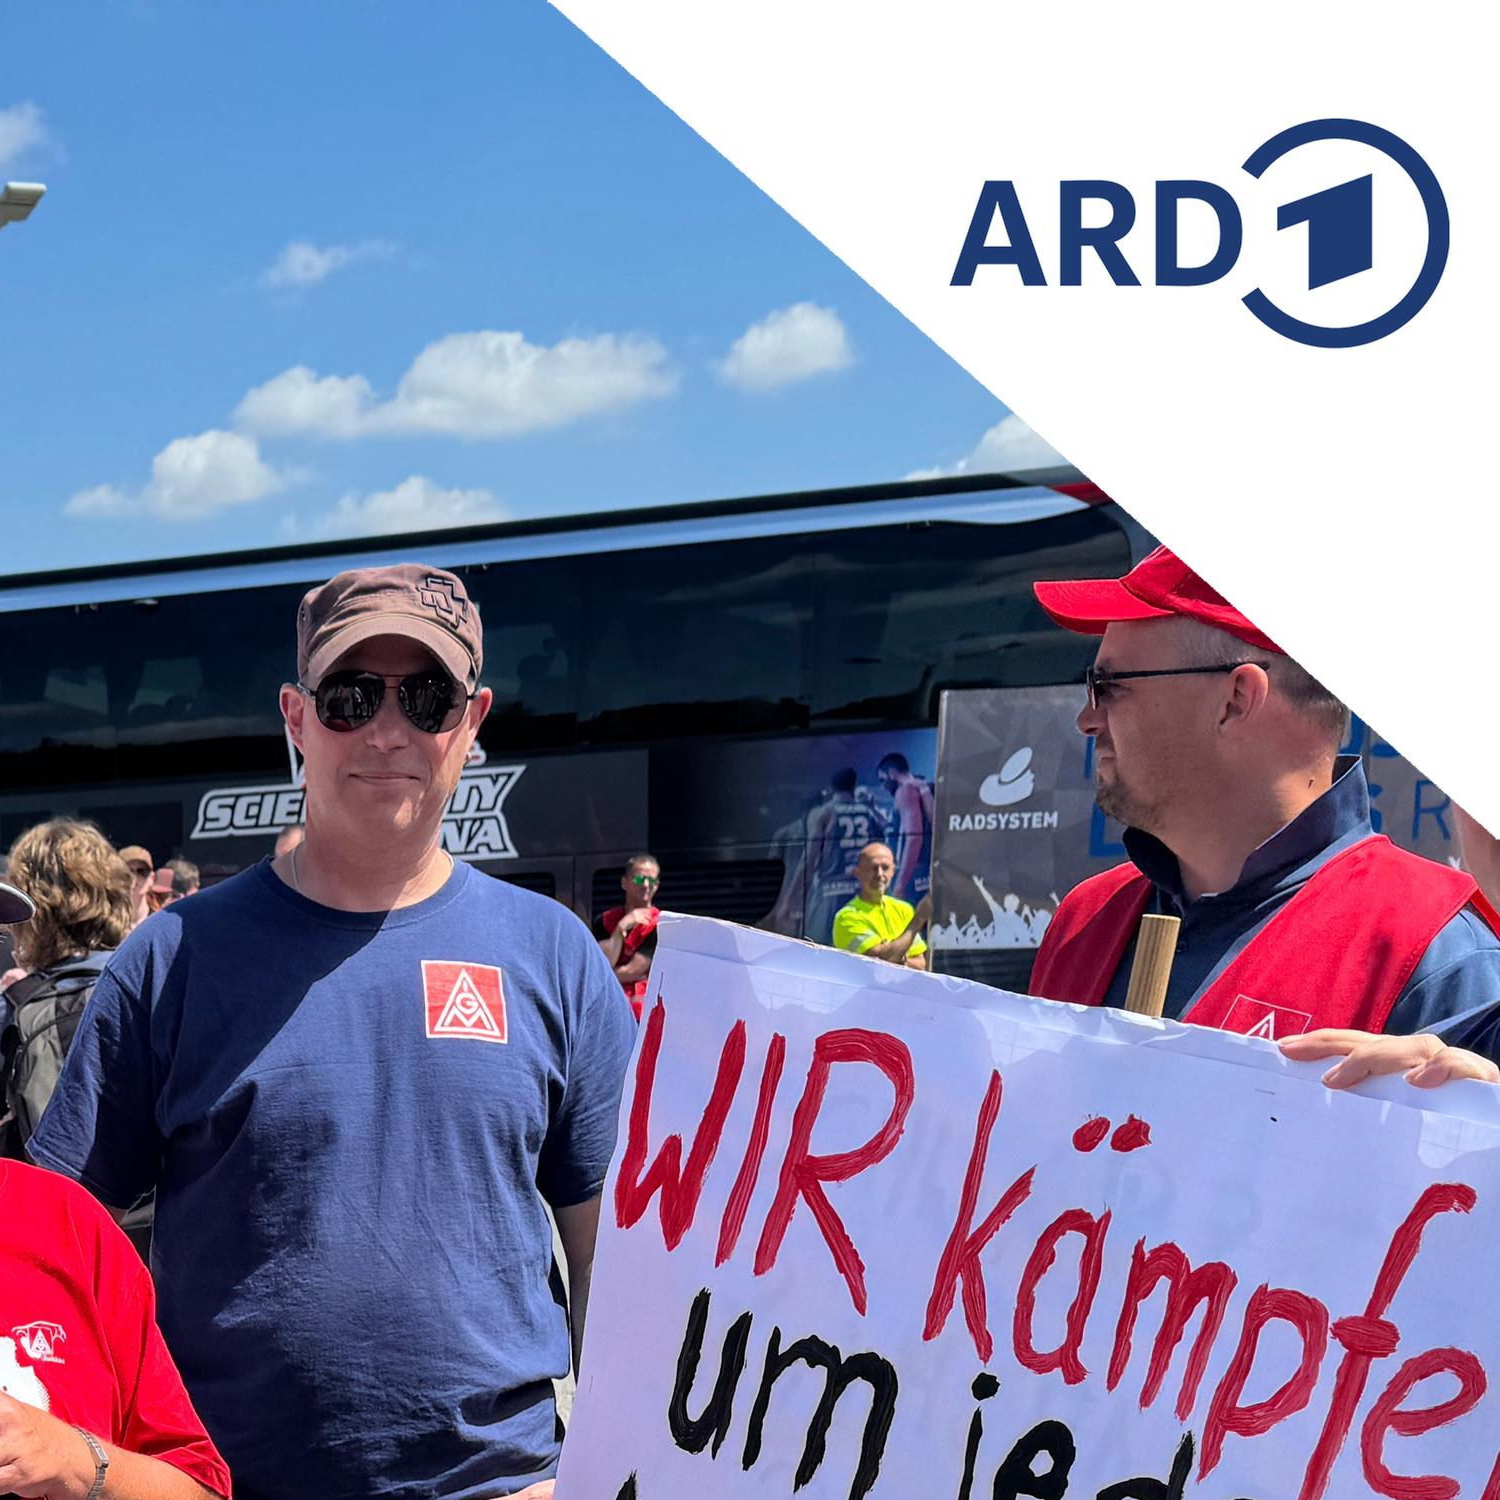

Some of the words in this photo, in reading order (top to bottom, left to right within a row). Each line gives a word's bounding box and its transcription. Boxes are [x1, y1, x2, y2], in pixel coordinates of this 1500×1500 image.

[204, 789, 306, 831] SCIE
[451, 772, 509, 813] TY
[441, 816, 503, 853] NA
[838, 815, 870, 848] 23
[948, 810, 1059, 832] RADSYSTEM
[614, 995, 915, 1317] WIR
